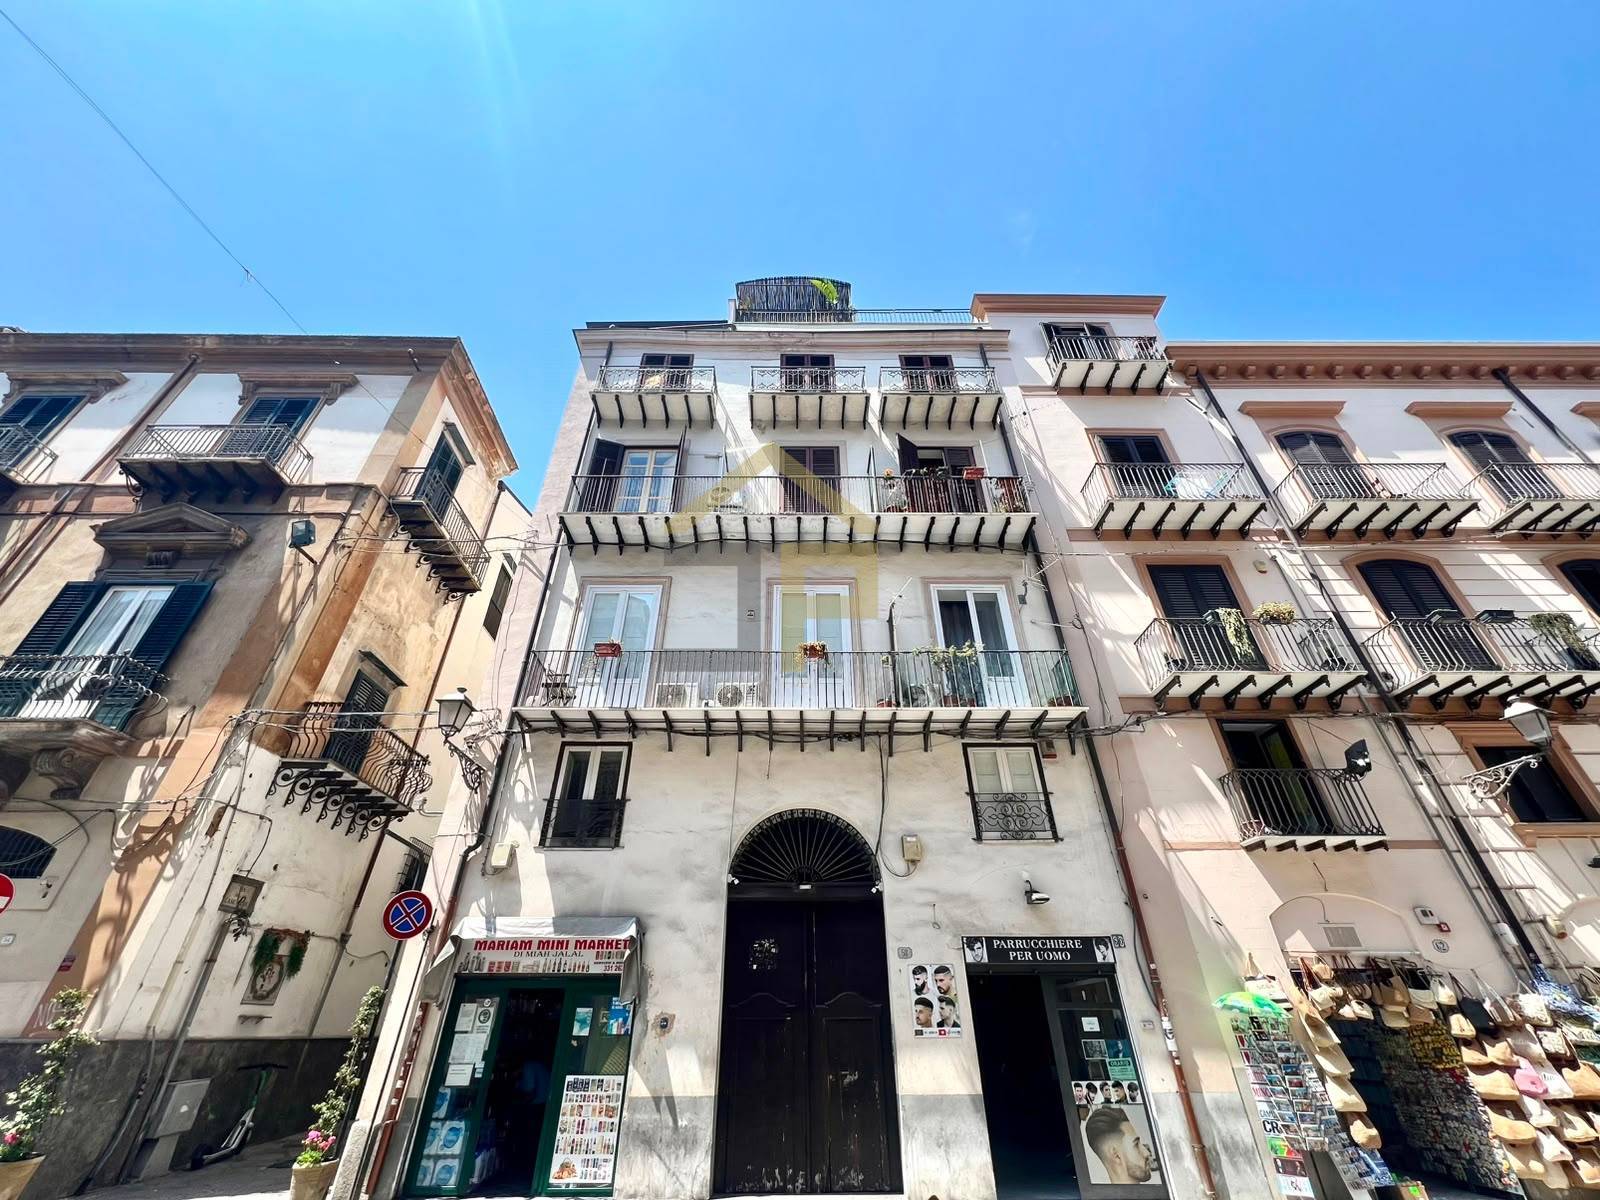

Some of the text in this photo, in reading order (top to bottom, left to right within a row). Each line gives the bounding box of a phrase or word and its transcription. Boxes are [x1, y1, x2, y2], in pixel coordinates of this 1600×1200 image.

[473, 939, 631, 951] MARIAM MINI MARKET
[993, 939, 1082, 949] PARRUCCHIERE
[1009, 951, 1071, 960] PER UOMO
